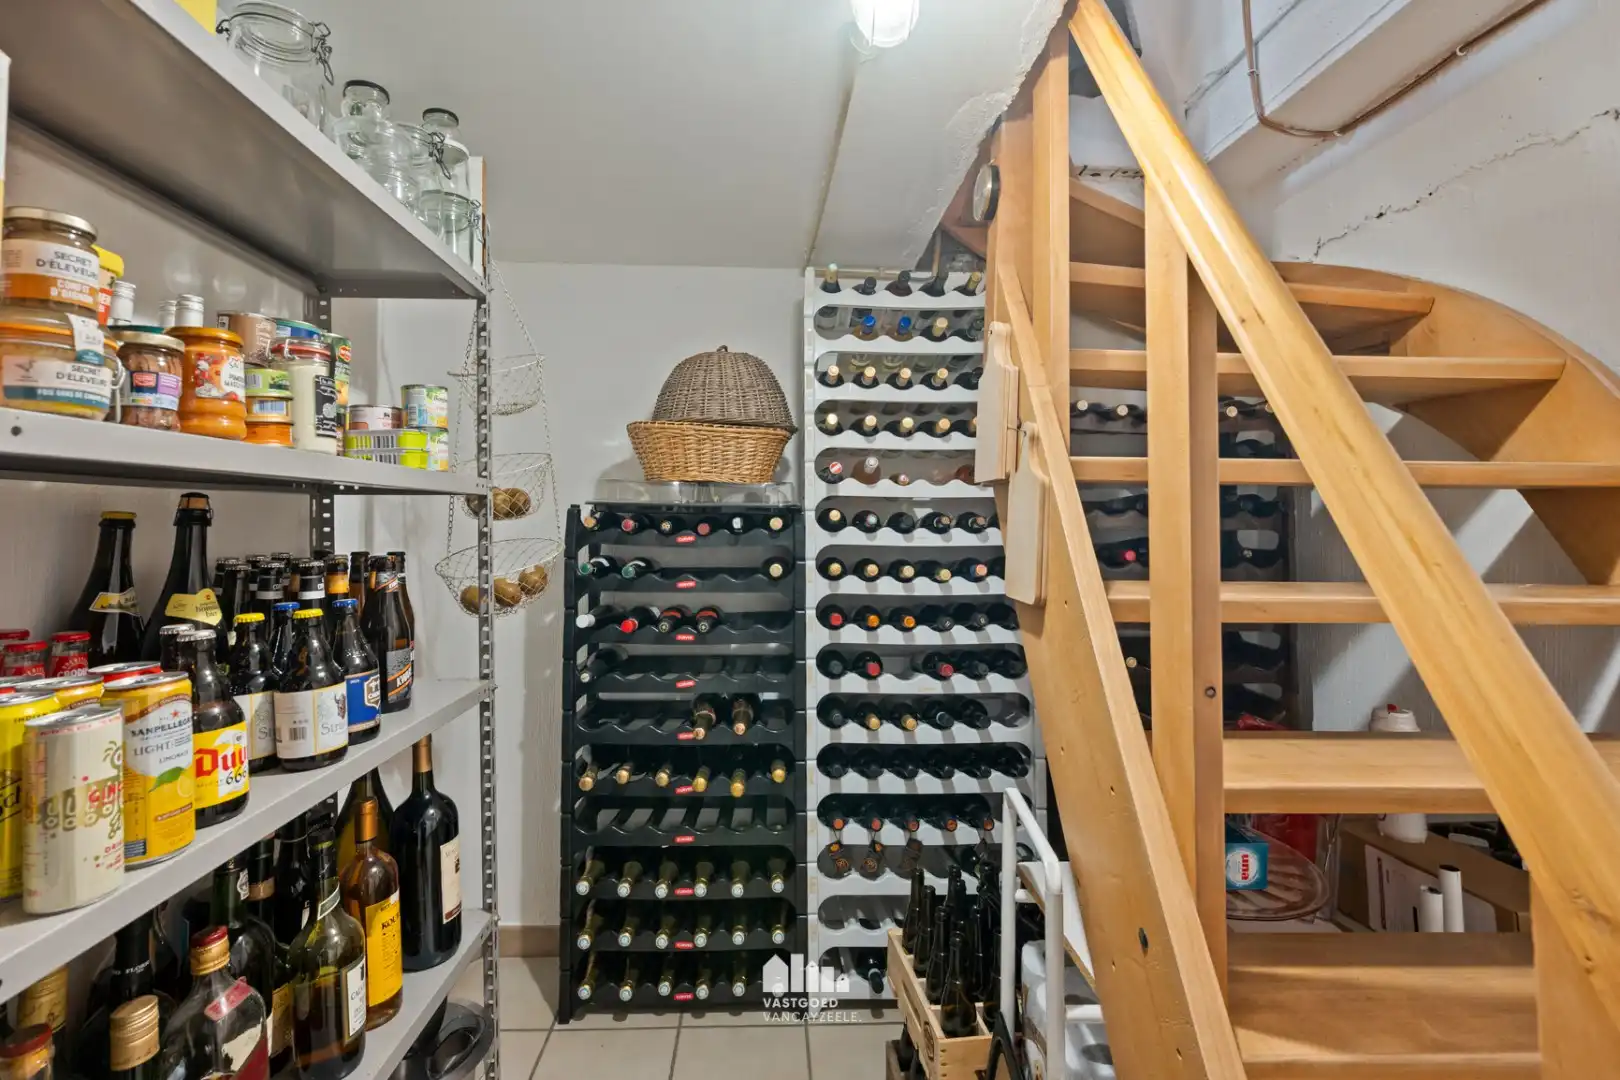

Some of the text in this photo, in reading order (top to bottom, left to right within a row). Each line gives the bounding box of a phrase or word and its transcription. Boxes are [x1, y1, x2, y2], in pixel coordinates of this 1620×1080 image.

[54, 250, 92, 267] SECRET
[71, 364, 101, 376] SECRET
[134, 740, 170, 757] LIGHT
